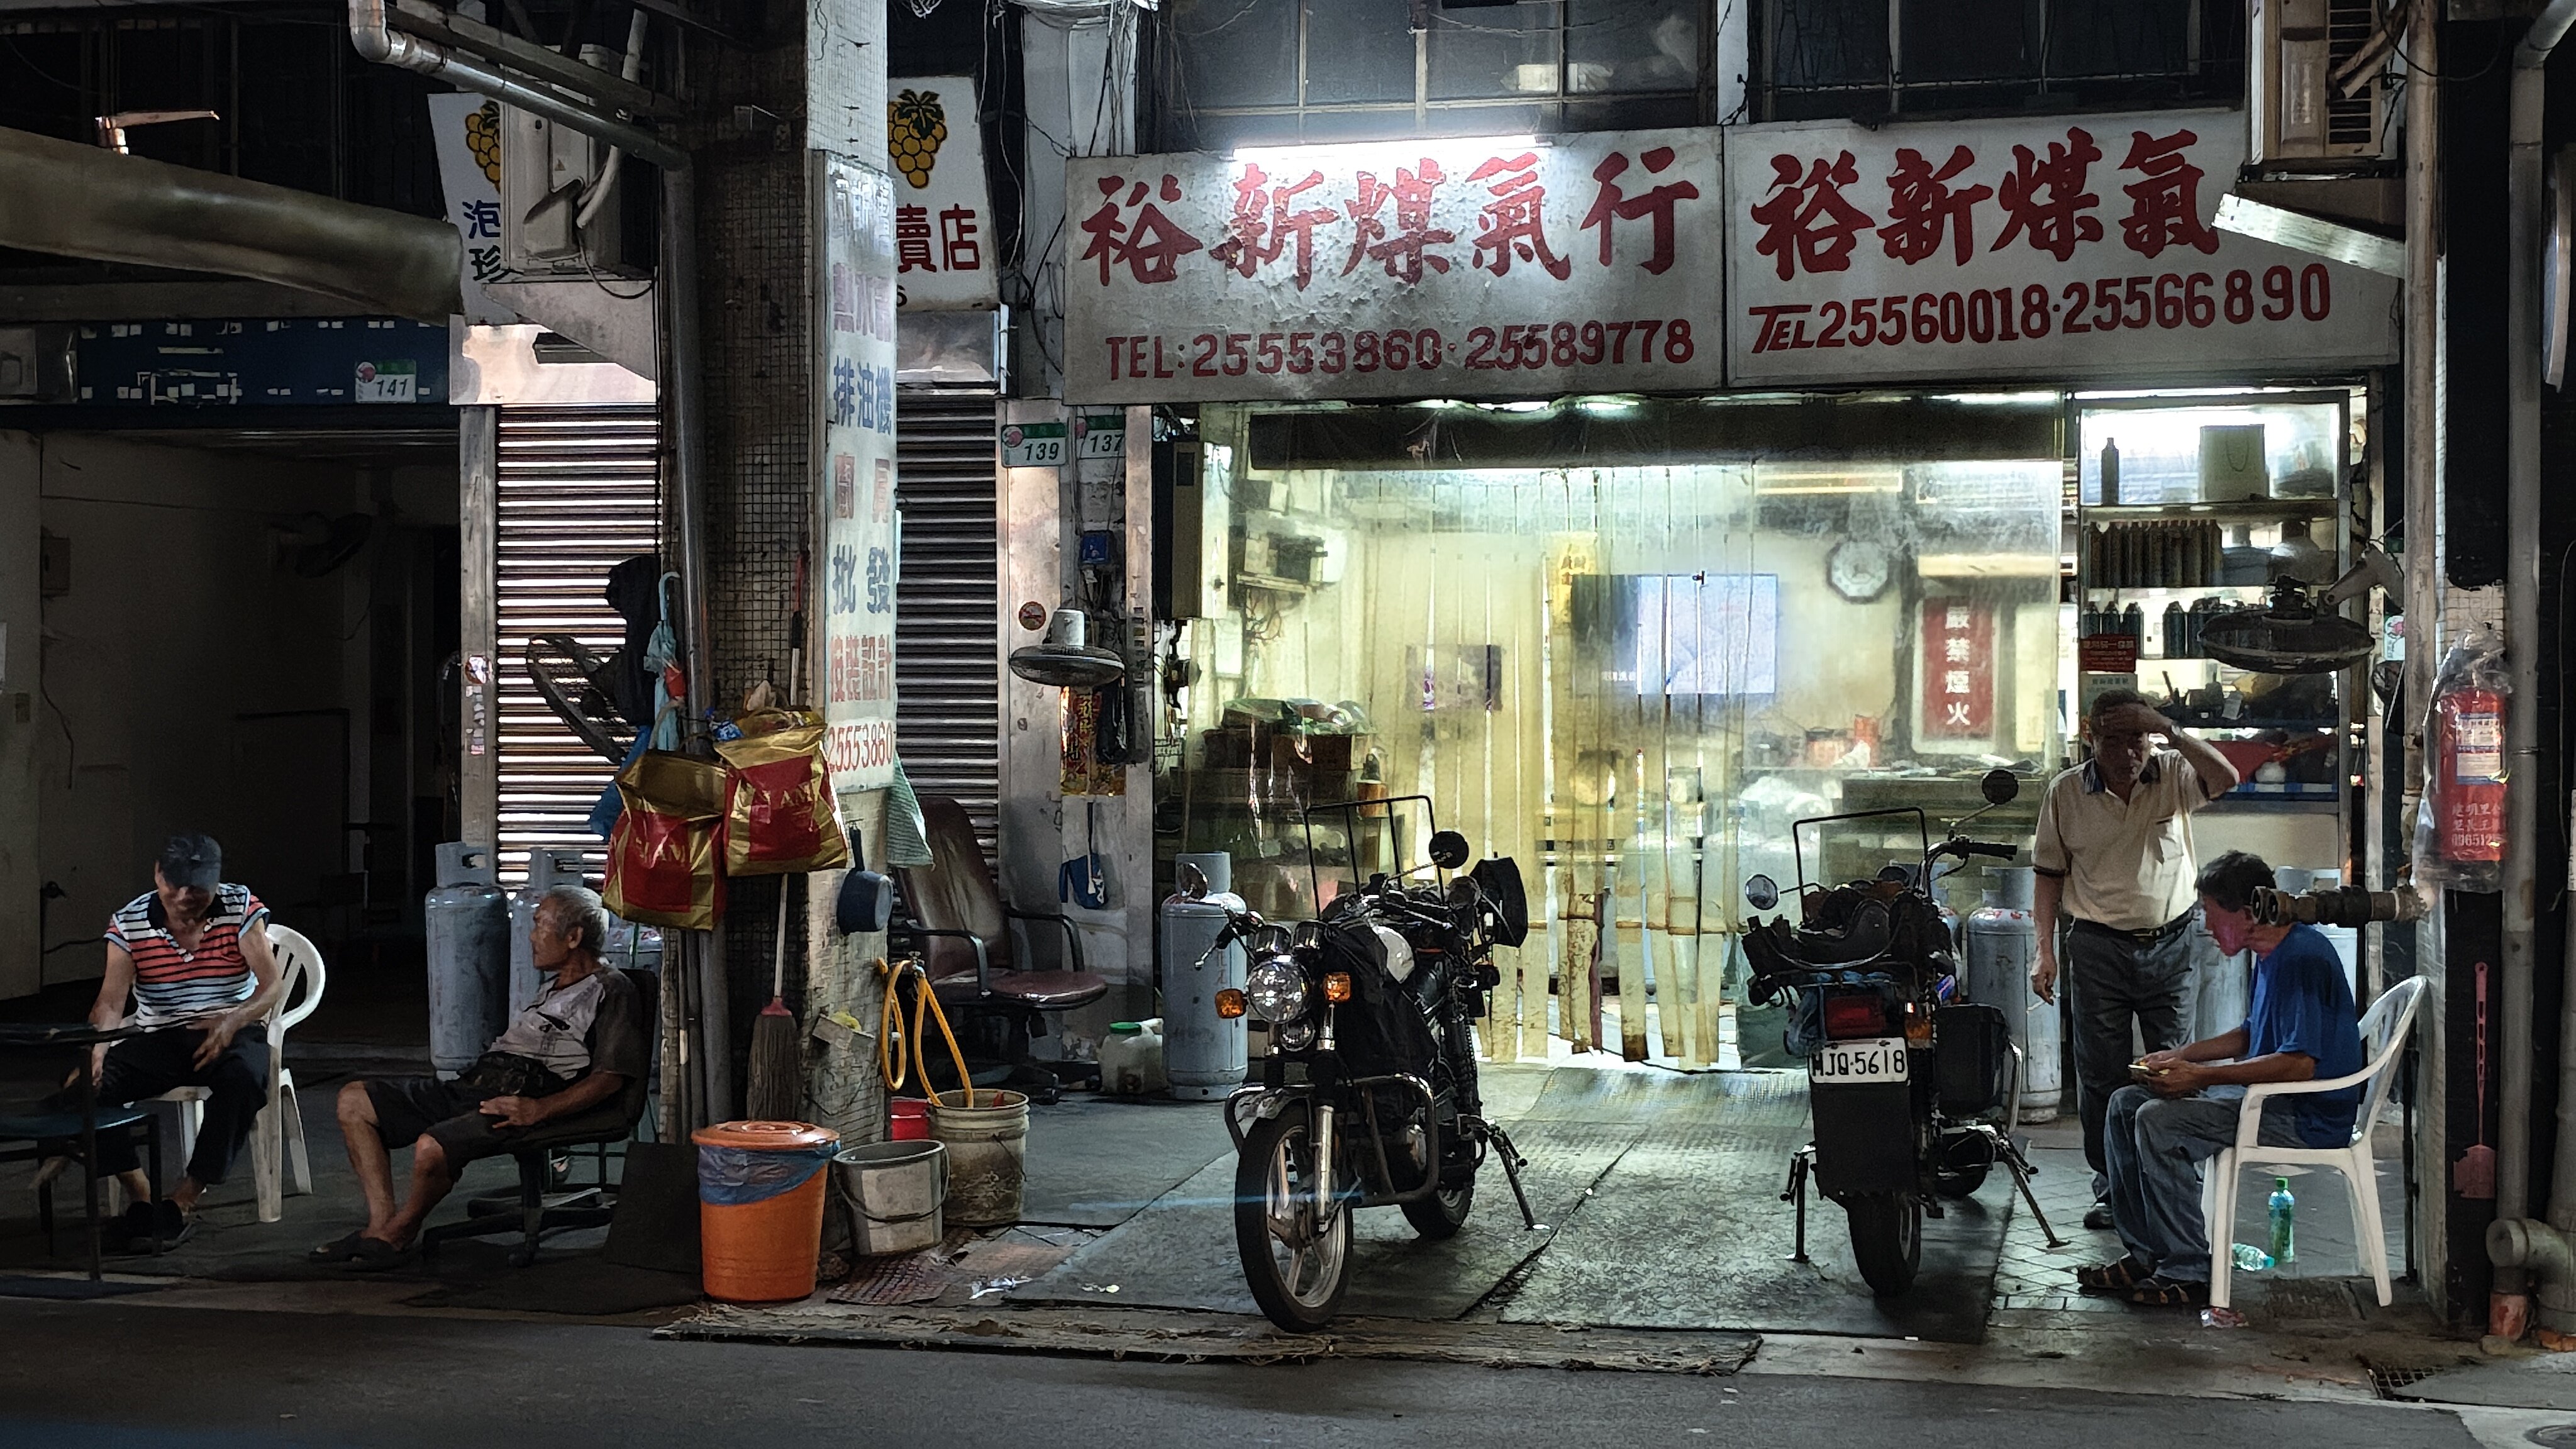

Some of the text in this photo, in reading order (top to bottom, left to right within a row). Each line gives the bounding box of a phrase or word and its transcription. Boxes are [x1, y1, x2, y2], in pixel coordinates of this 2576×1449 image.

[1081, 147, 1699, 292] 裕新煤氣行
[1751, 127, 2219, 281] 裕新煤氣
[377, 379, 408, 396] 141
[1024, 442, 1059, 460] 139
[1090, 434, 1124, 453] 137
[833, 544, 891, 615] 批發
[828, 721, 892, 773] 25553860
